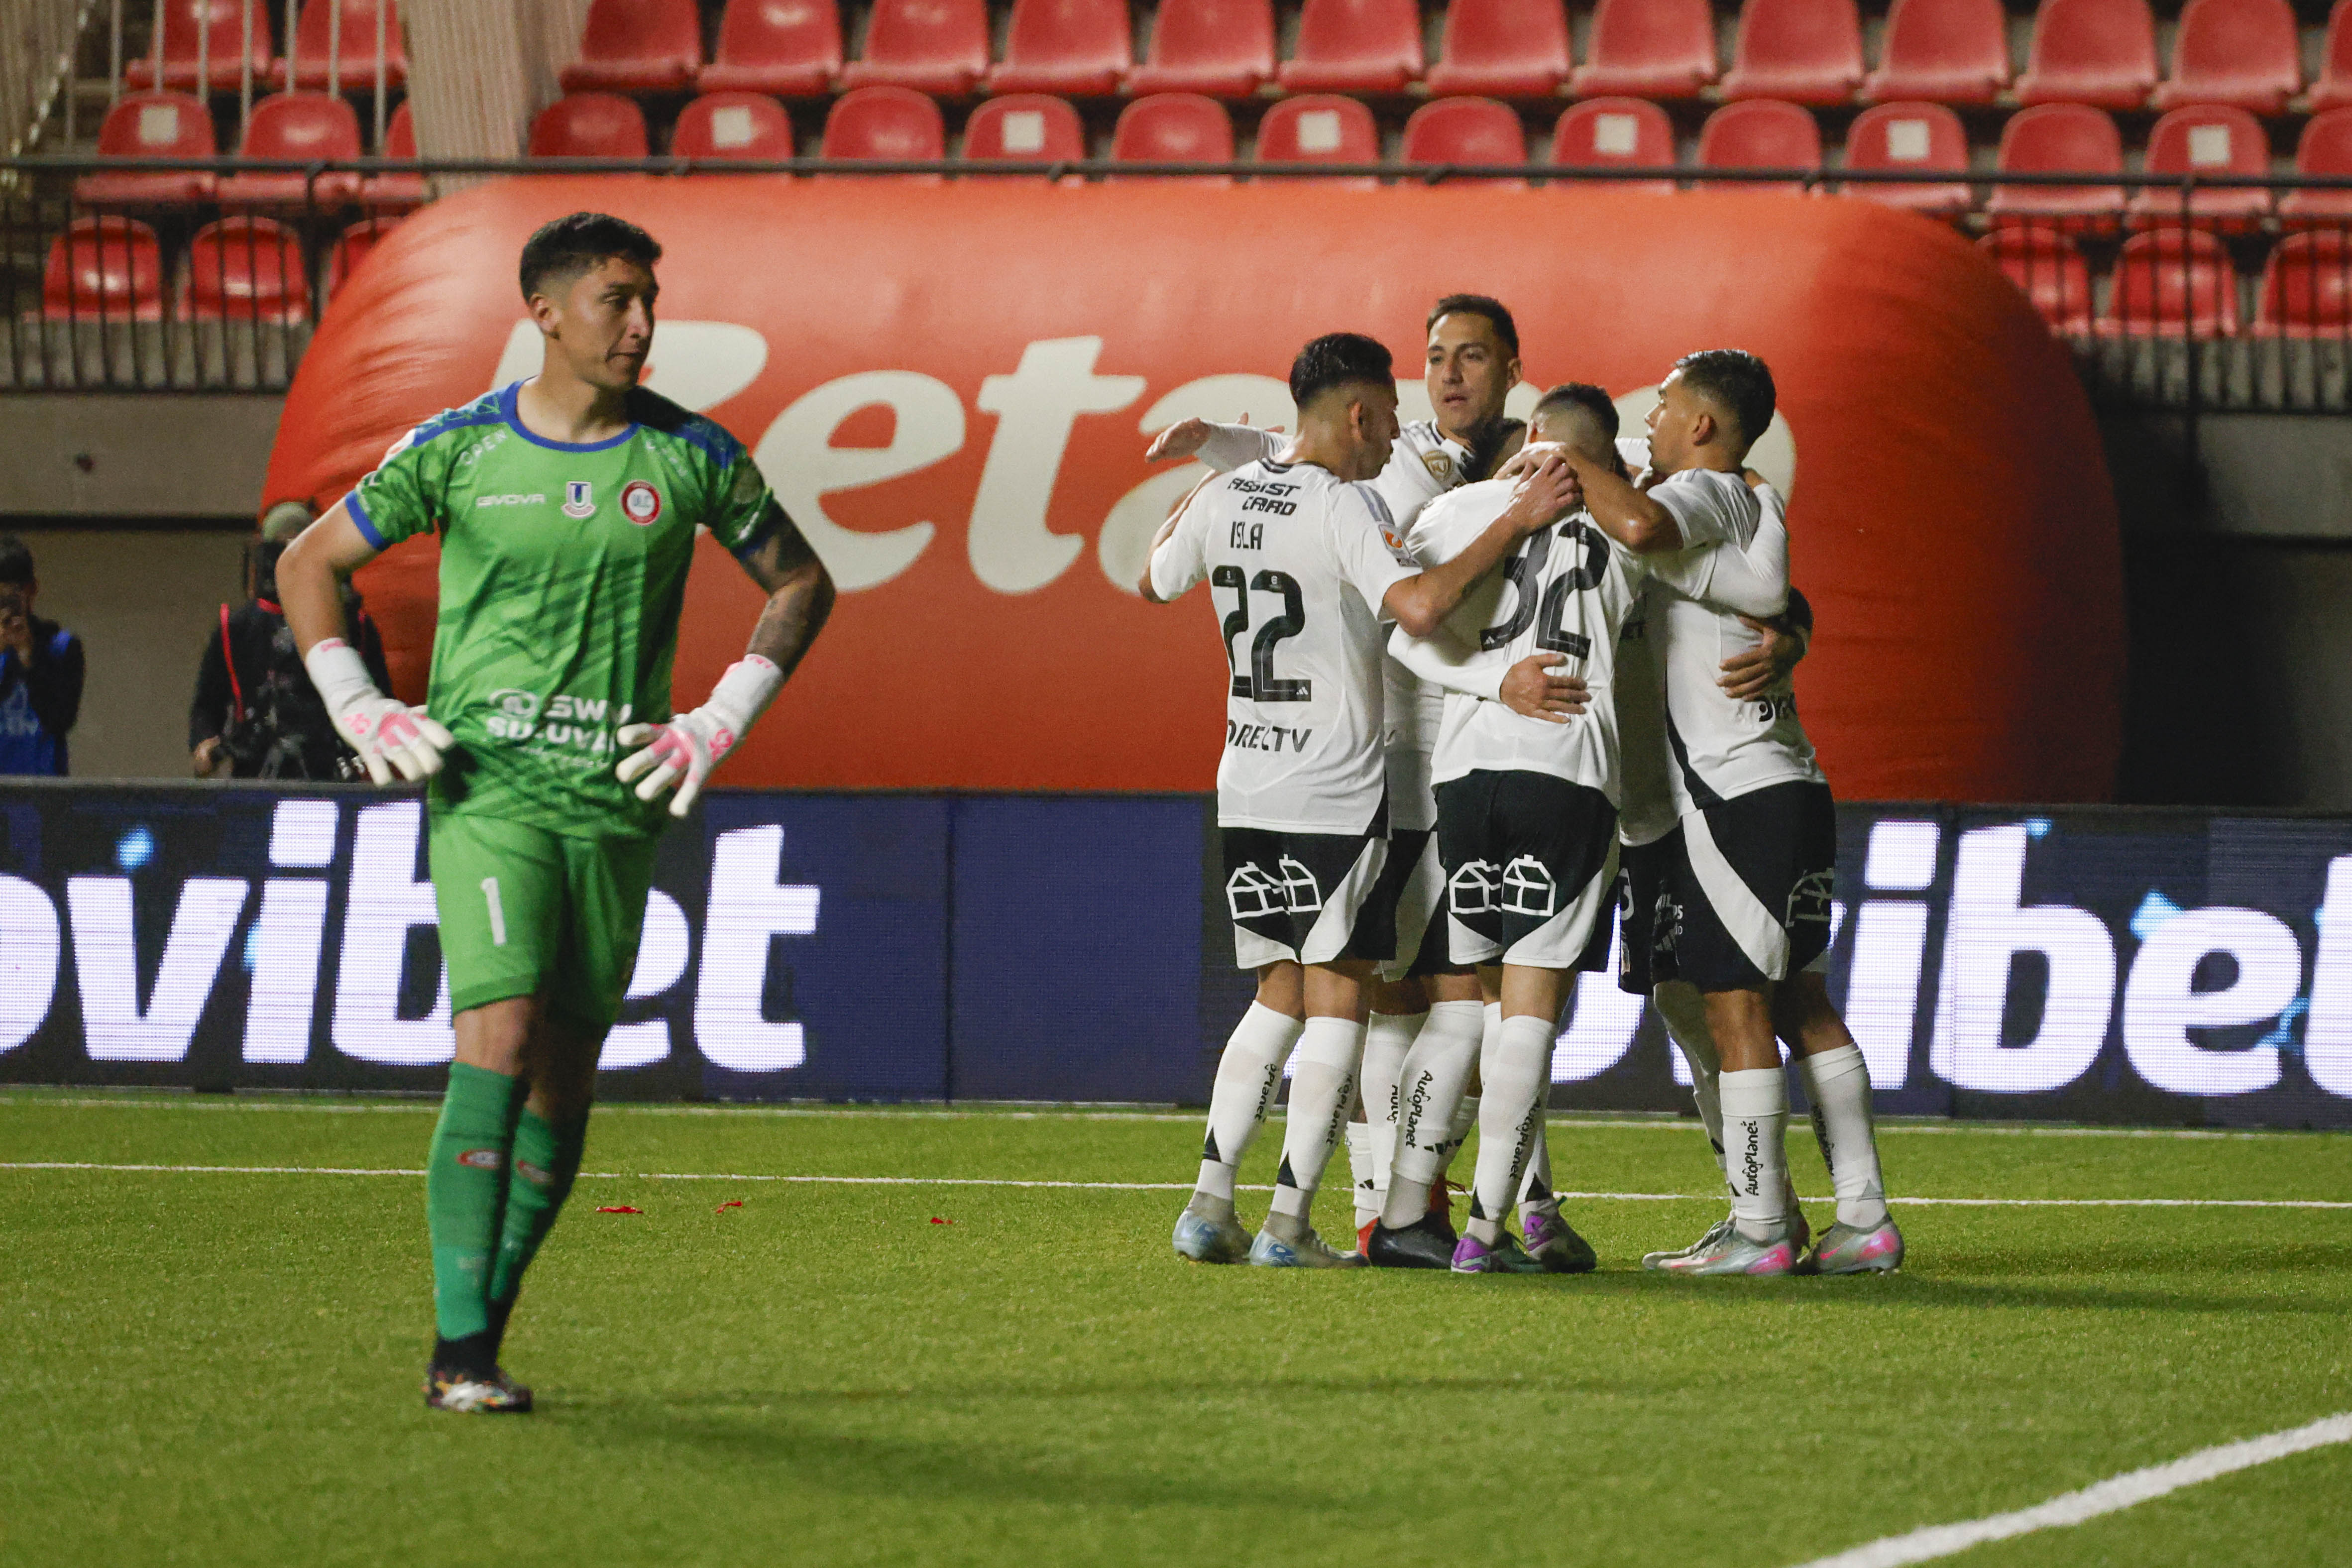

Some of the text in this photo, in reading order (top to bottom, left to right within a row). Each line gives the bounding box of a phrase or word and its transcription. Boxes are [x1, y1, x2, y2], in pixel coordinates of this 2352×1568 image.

[1227, 477, 1302, 497] ASSIST
[1242, 496, 1297, 516] CARD
[1230, 521, 1263, 550] ISLA
[1480, 515, 1613, 661] 32
[1212, 564, 1312, 702] 22
[1228, 719, 1313, 753] DRECTV
[480, 877, 508, 945] 1
[1405, 1069, 1434, 1148] AutoPlanet
